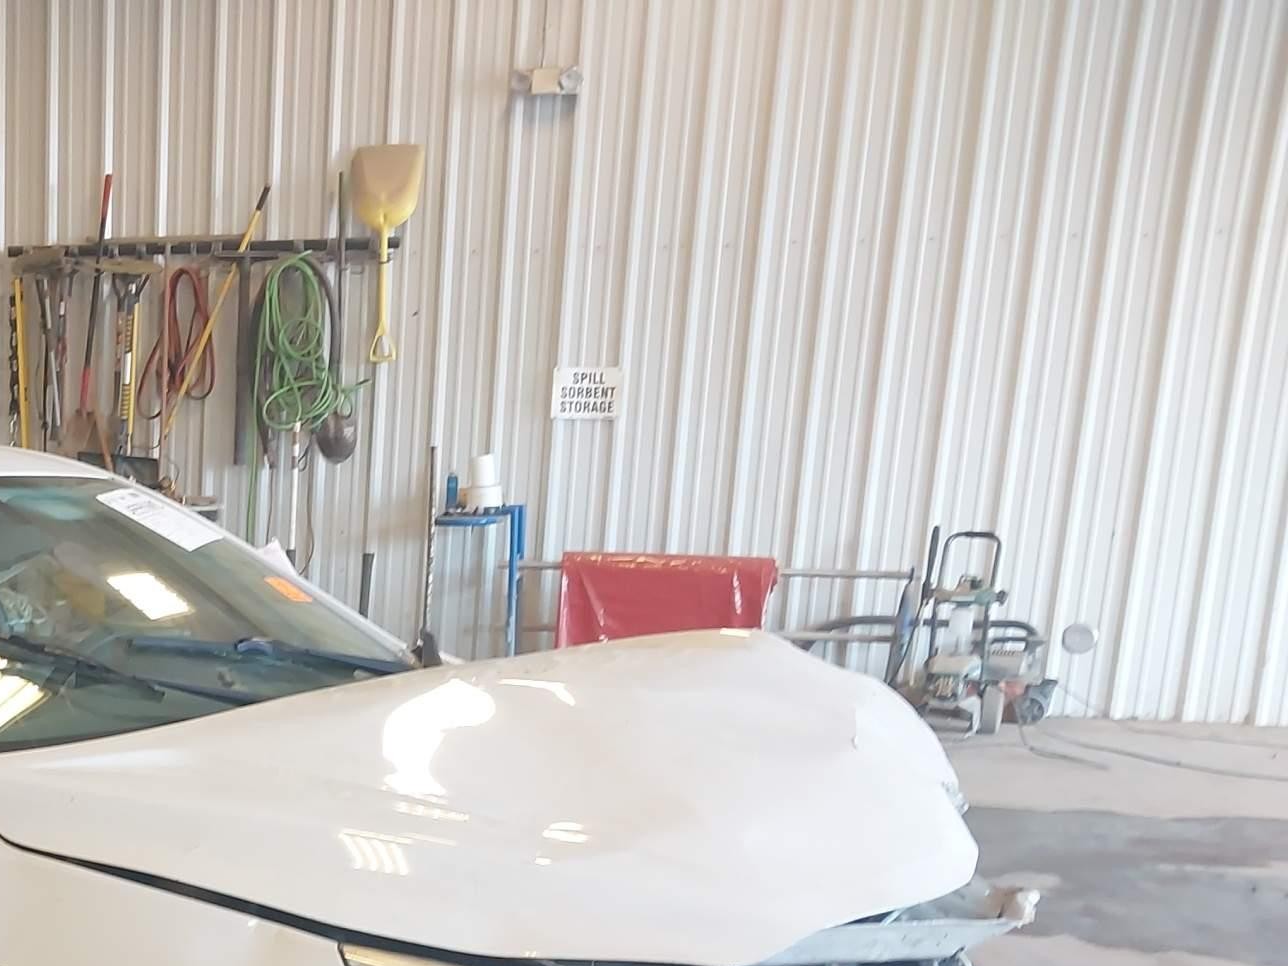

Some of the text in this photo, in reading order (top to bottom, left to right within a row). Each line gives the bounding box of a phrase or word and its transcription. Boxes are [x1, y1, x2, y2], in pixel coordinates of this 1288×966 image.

[572, 371, 605, 385] SPILL
[560, 386, 616, 399] SORBENT
[559, 400, 614, 413] STORAGE
